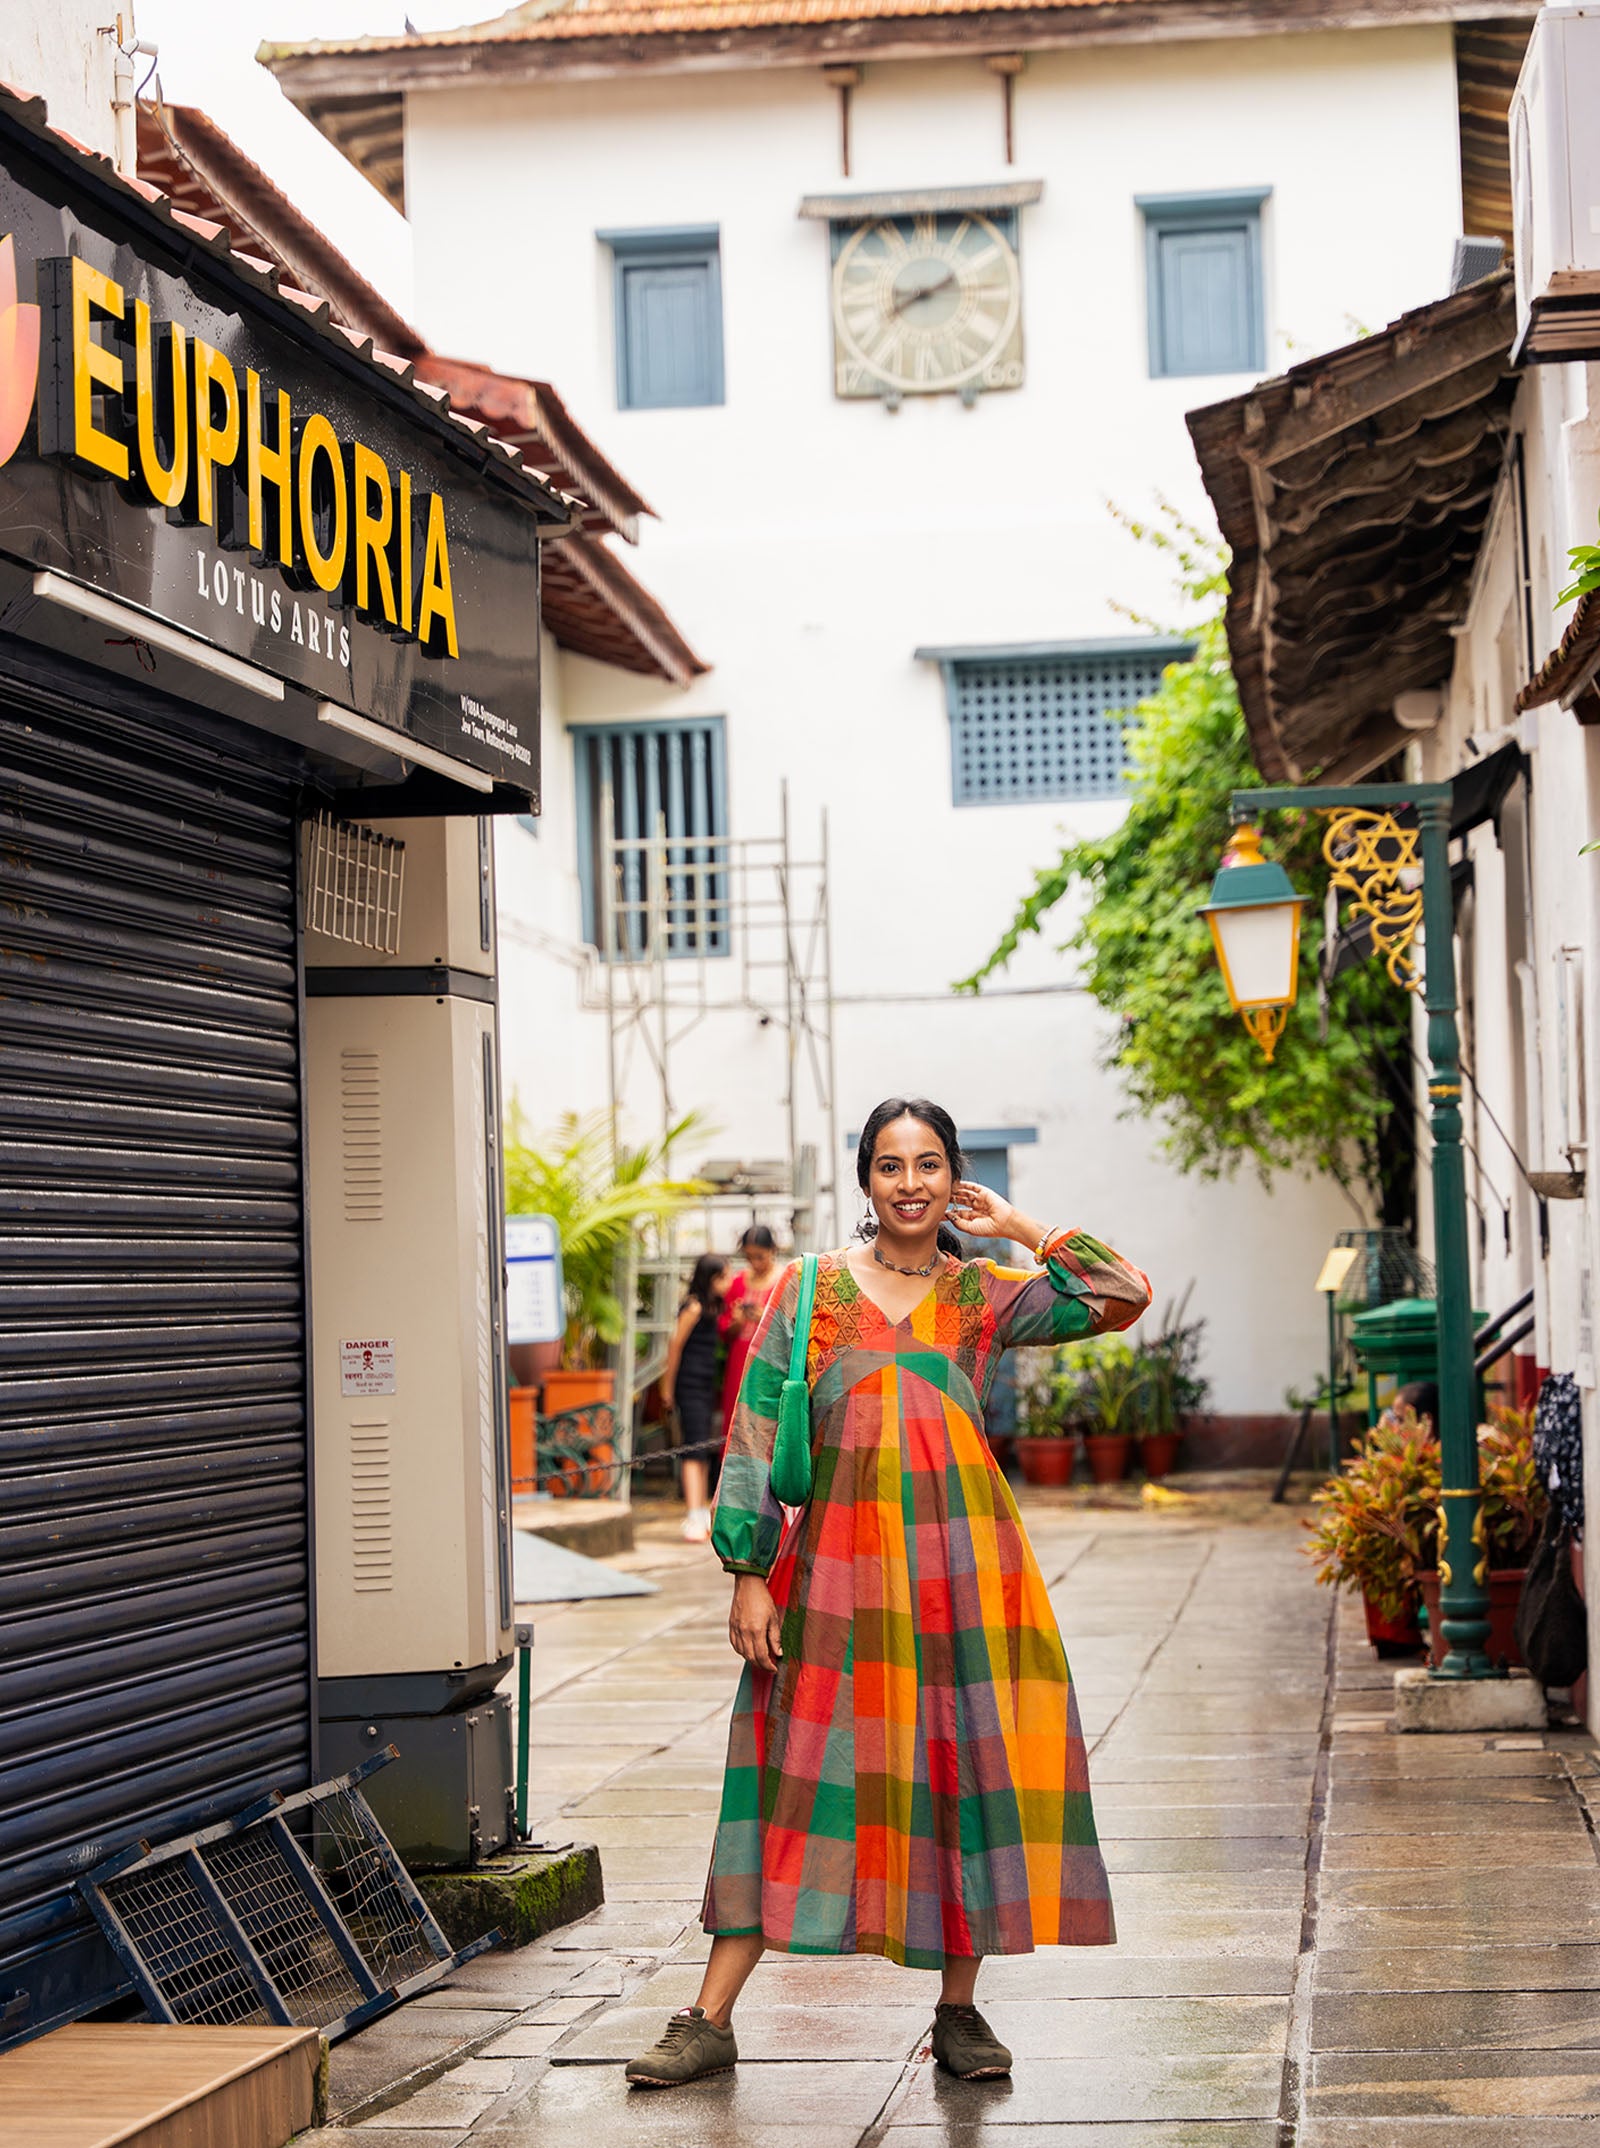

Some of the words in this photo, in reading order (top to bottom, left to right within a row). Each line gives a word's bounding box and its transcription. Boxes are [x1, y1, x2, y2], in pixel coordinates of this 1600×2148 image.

[72, 255, 459, 660] EUPHORIA
[197, 551, 282, 634] LOTUS
[290, 609, 351, 667] ARTS
[461, 716, 471, 735] Jew
[506, 718, 518, 738] Lane
[346, 1341, 389, 1349] DANGER
